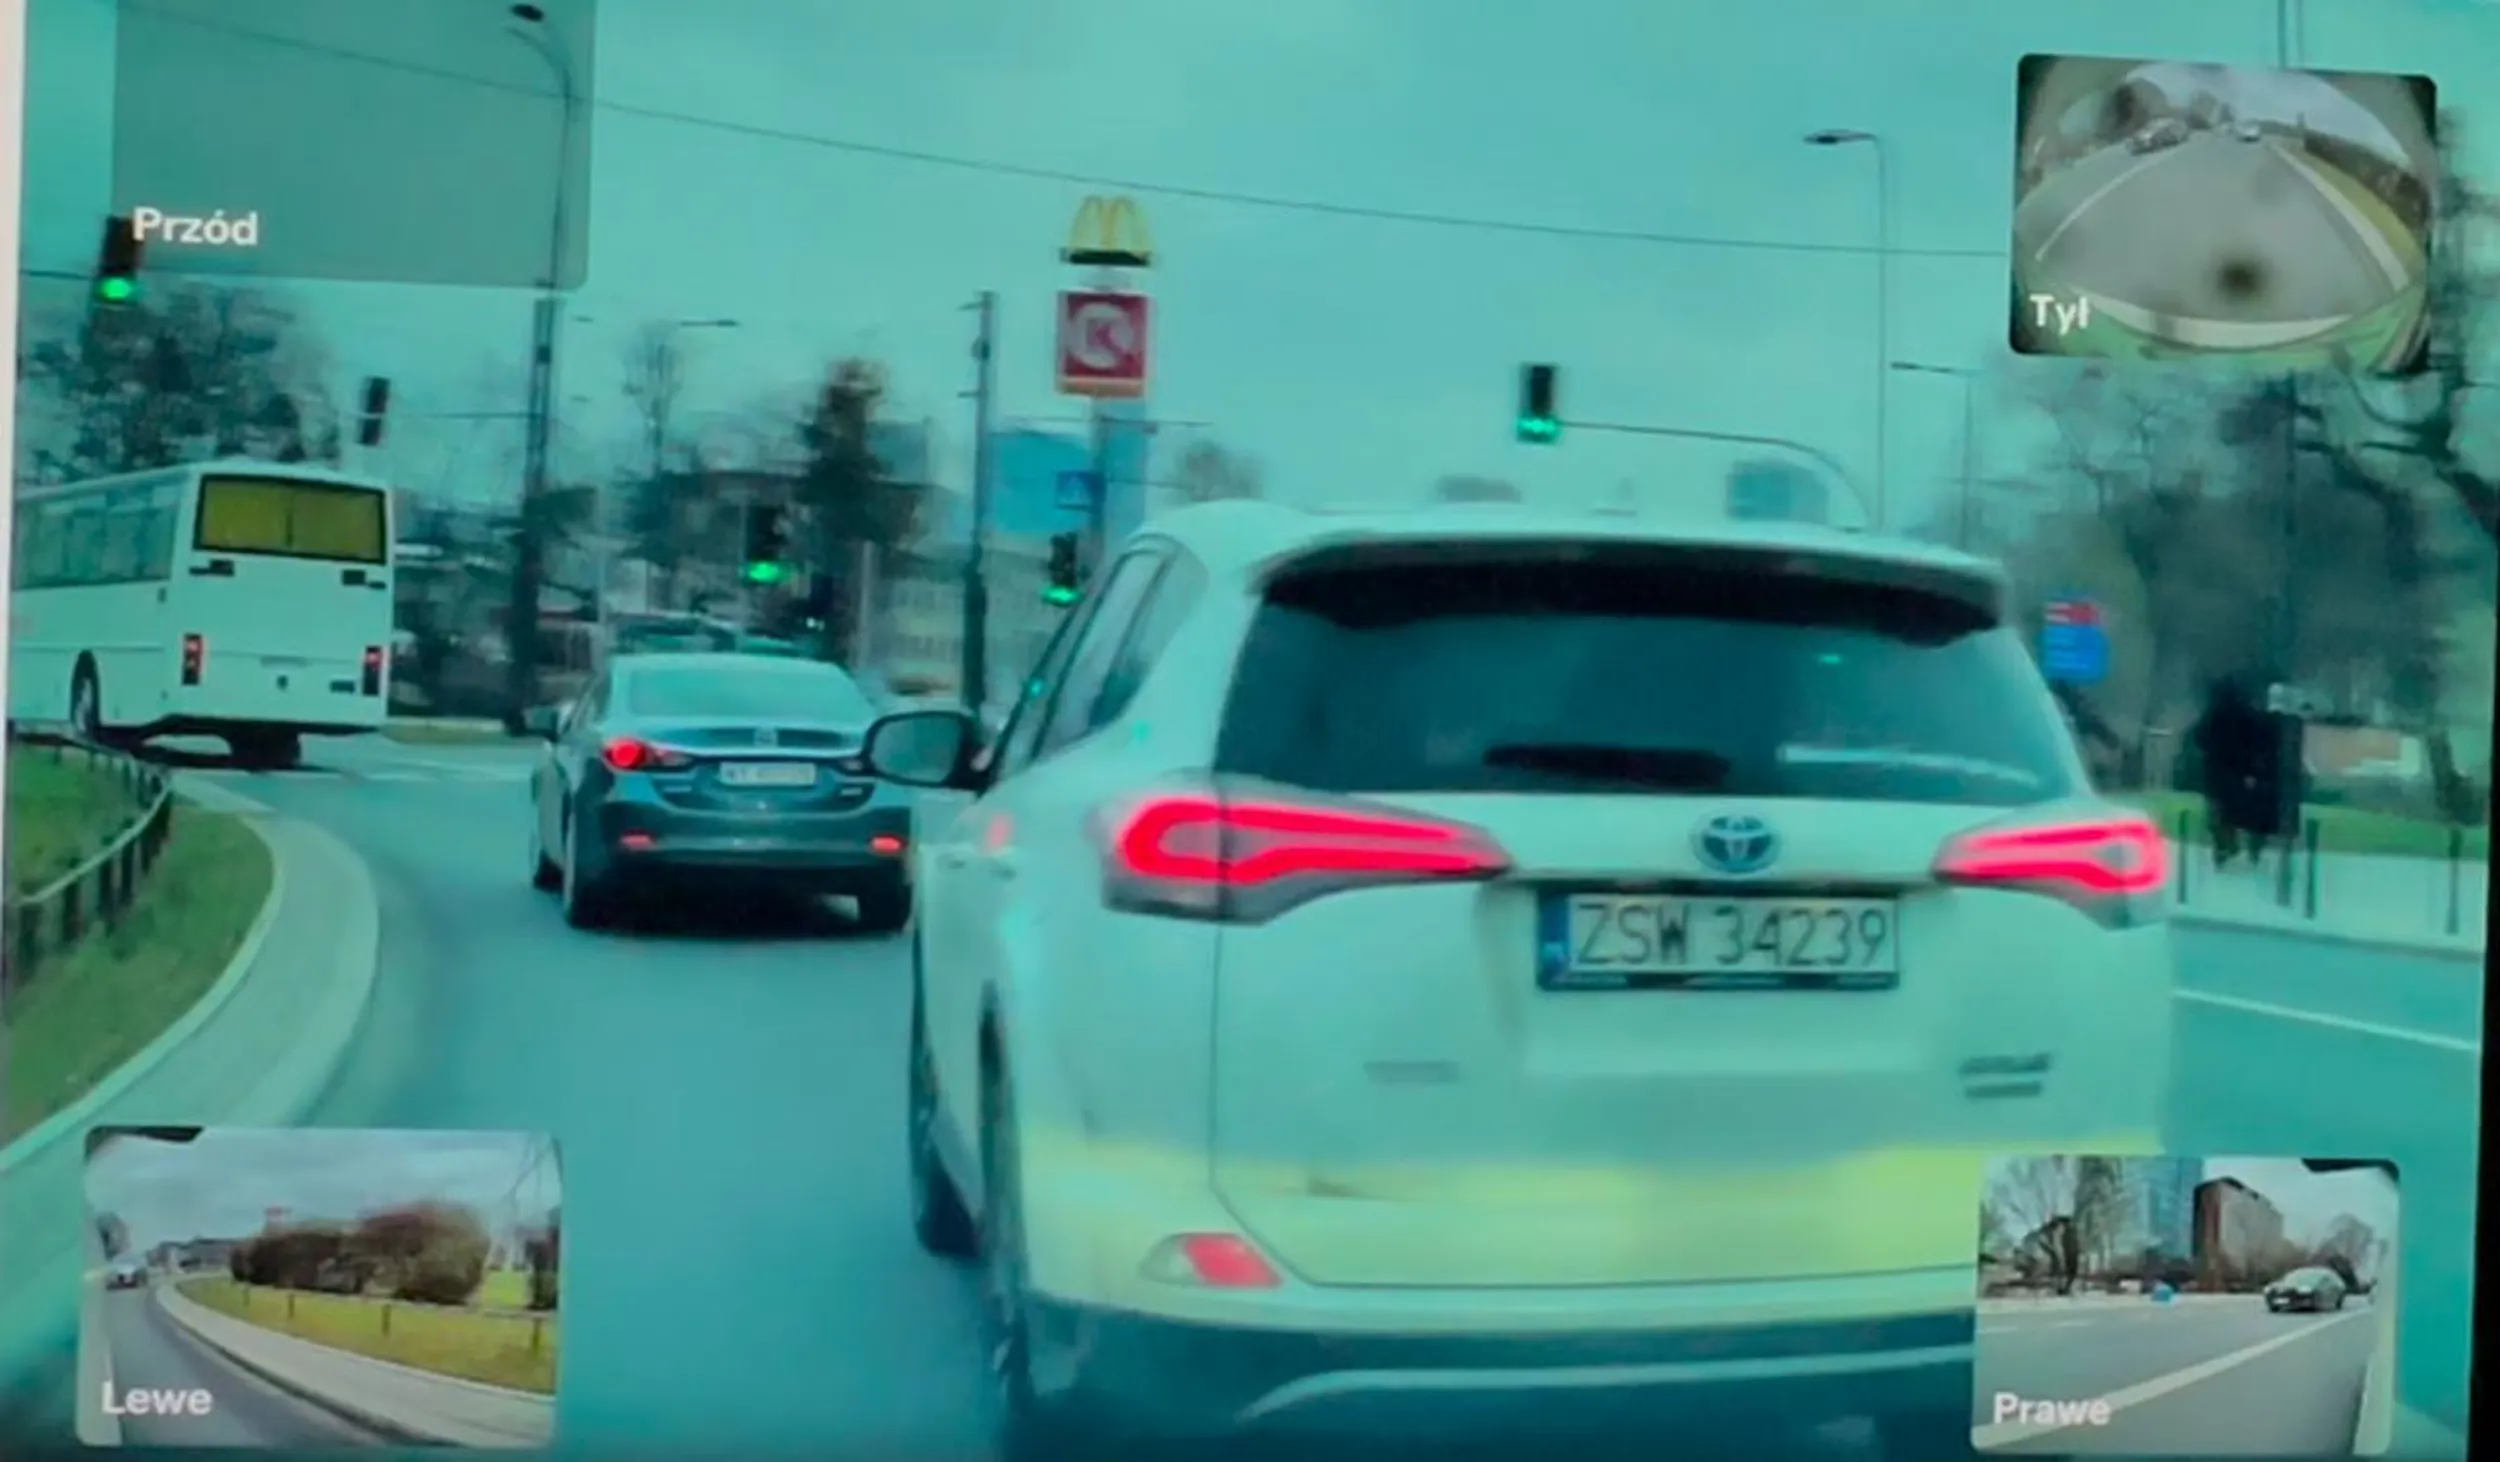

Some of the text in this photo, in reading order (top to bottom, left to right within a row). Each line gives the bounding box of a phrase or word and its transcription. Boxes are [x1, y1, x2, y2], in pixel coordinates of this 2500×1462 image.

[133, 206, 258, 246] Przód
[1577, 902, 1886, 967] ZSW 34239
[102, 1379, 213, 1415] Lewe
[1994, 1391, 2110, 1426] Prawe
